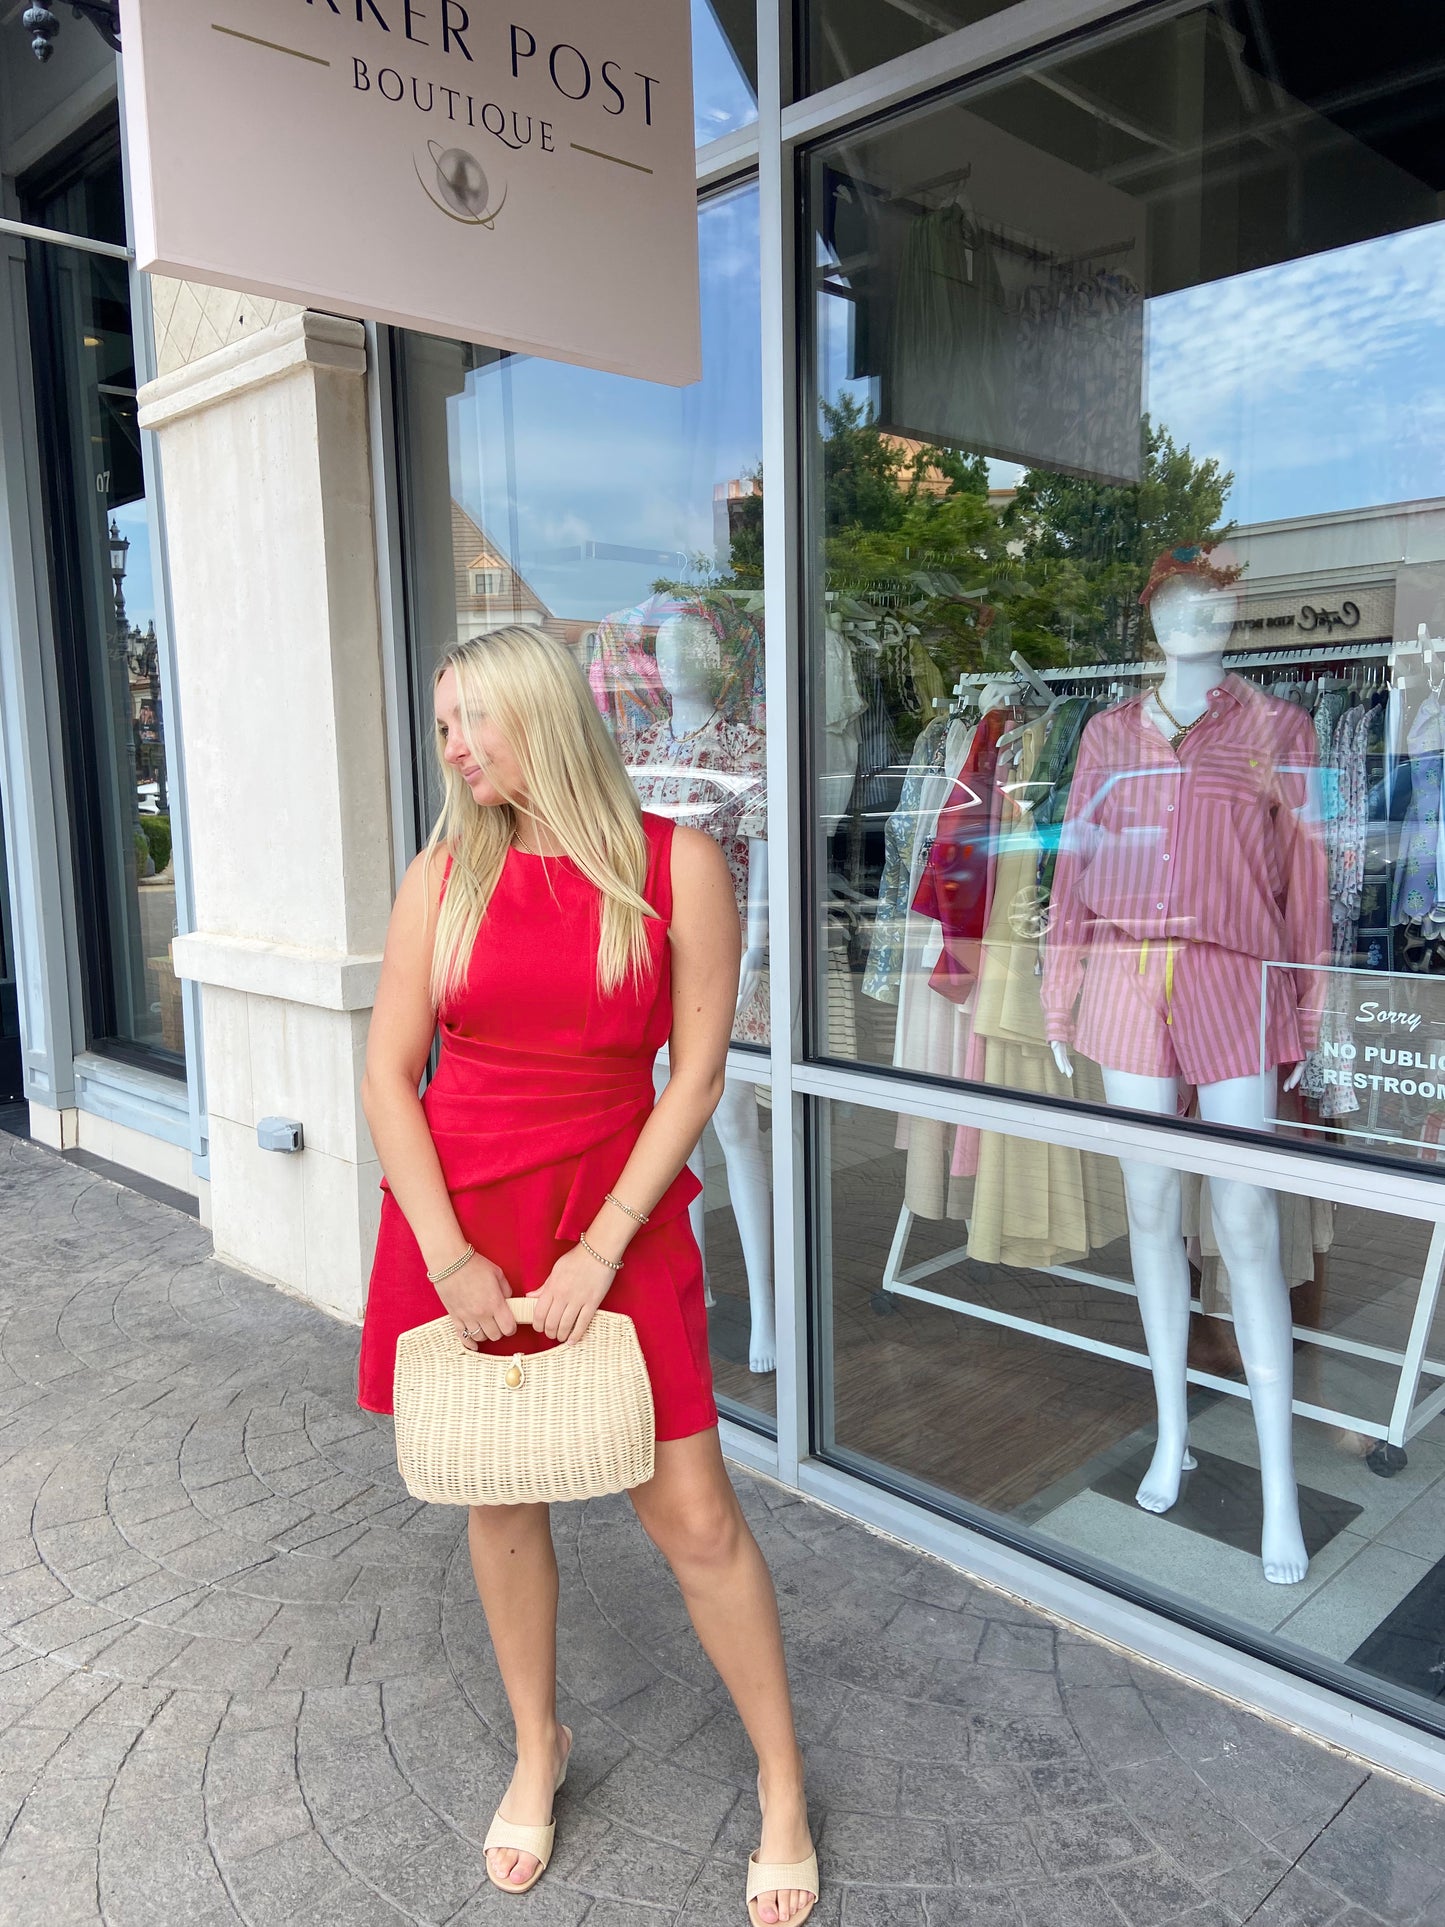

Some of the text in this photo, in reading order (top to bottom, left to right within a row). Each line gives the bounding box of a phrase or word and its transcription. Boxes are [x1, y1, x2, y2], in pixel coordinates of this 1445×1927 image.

[306, 0, 661, 126] ER POST
[352, 56, 556, 153] BOUTIQUE
[1355, 1002, 1422, 1032] Sorry
[1323, 1041, 1357, 1060] NO
